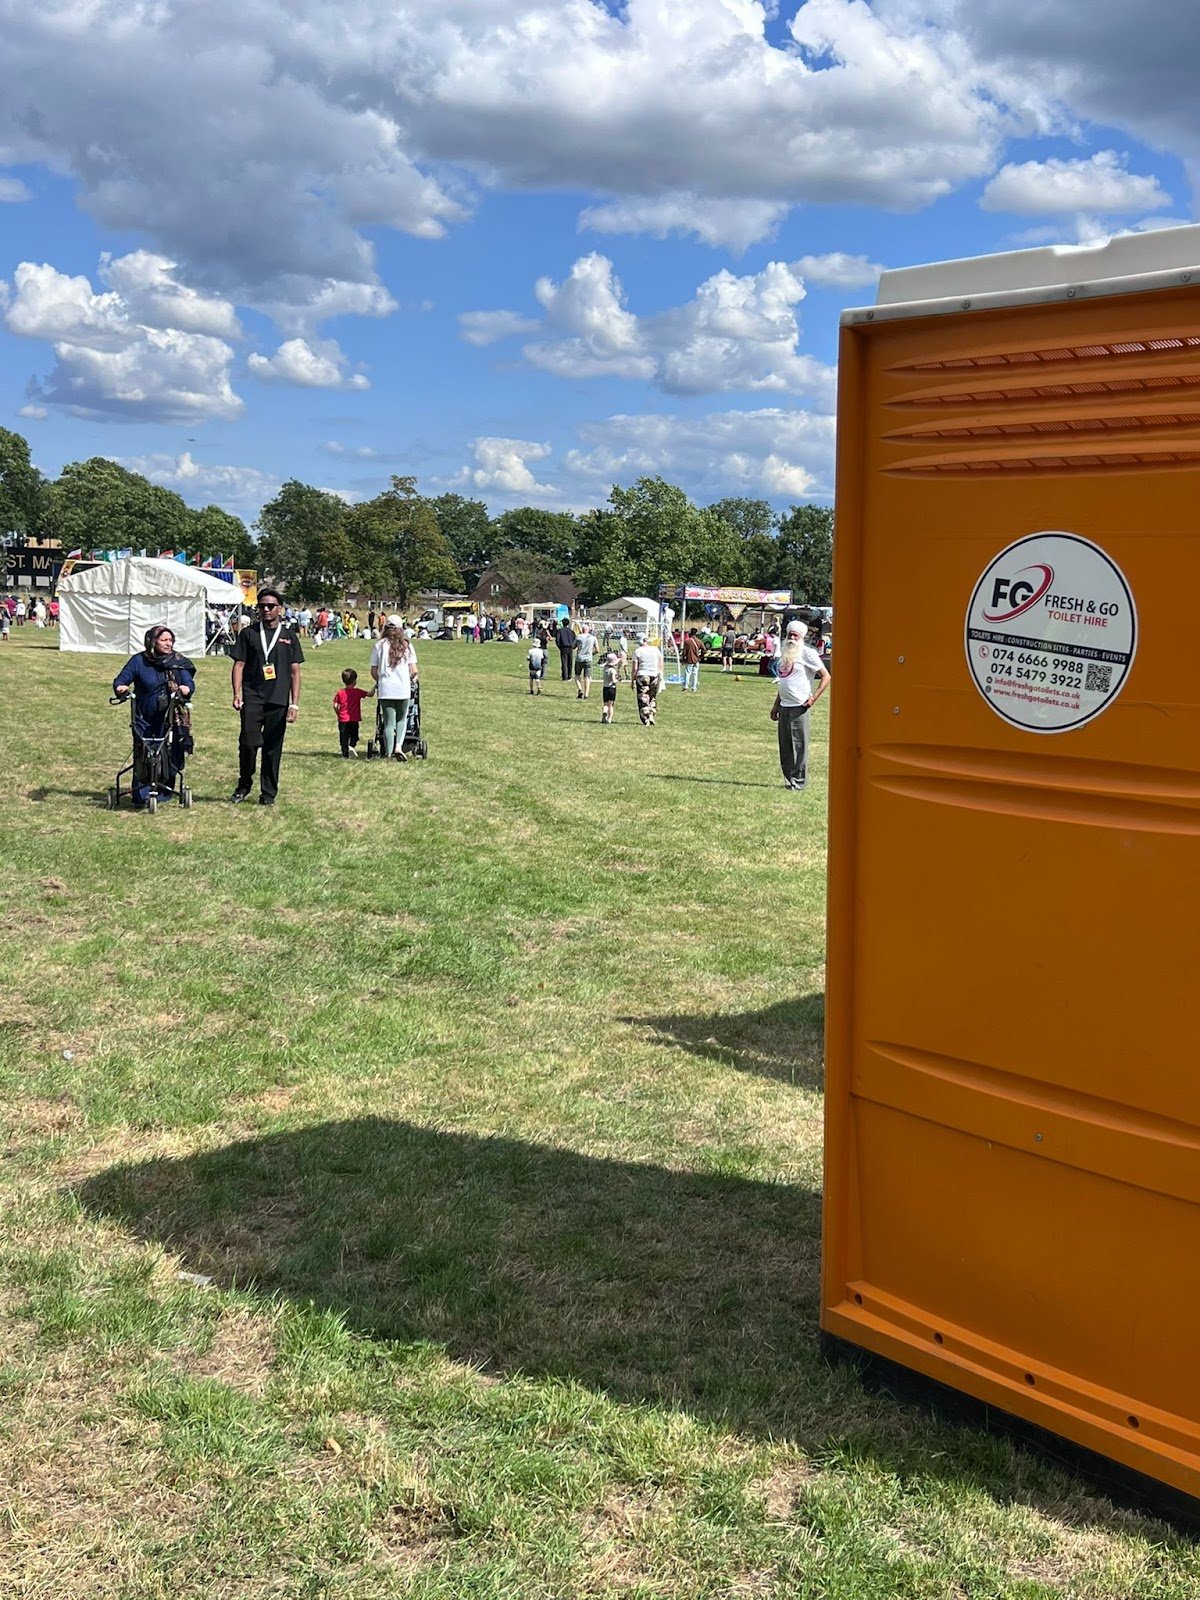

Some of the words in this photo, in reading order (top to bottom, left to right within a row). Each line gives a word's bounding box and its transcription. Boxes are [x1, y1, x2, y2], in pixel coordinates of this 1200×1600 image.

[7, 554, 26, 568] ST.
[991, 577, 1034, 609] FG
[1045, 594, 1083, 611] FRESH
[1086, 600, 1096, 613] &
[1099, 602, 1119, 616] GO
[1048, 610, 1081, 624] TOILET
[1083, 616, 1108, 628] HIRE
[971, 630, 991, 640] TOILETS
[992, 633, 1005, 643] HIRE
[1007, 636, 1052, 650] CONSTRUCTION
[1052, 643, 1069, 653] SITES
[1072, 647, 1098, 658] PARTIES
[1101, 651, 1126, 662] EVENTS
[992, 648, 1014, 662] 074
[1017, 653, 1048, 667] 6666
[1052, 658, 1084, 674] 9988
[990, 663, 1012, 676] 074
[1016, 667, 1047, 682] 5479
[1050, 673, 1081, 689] 3922
[994, 676, 1080, 699] info@freshgotoilets.co.uk
[993, 687, 1080, 710] www.freshgotoilets.co.uk
